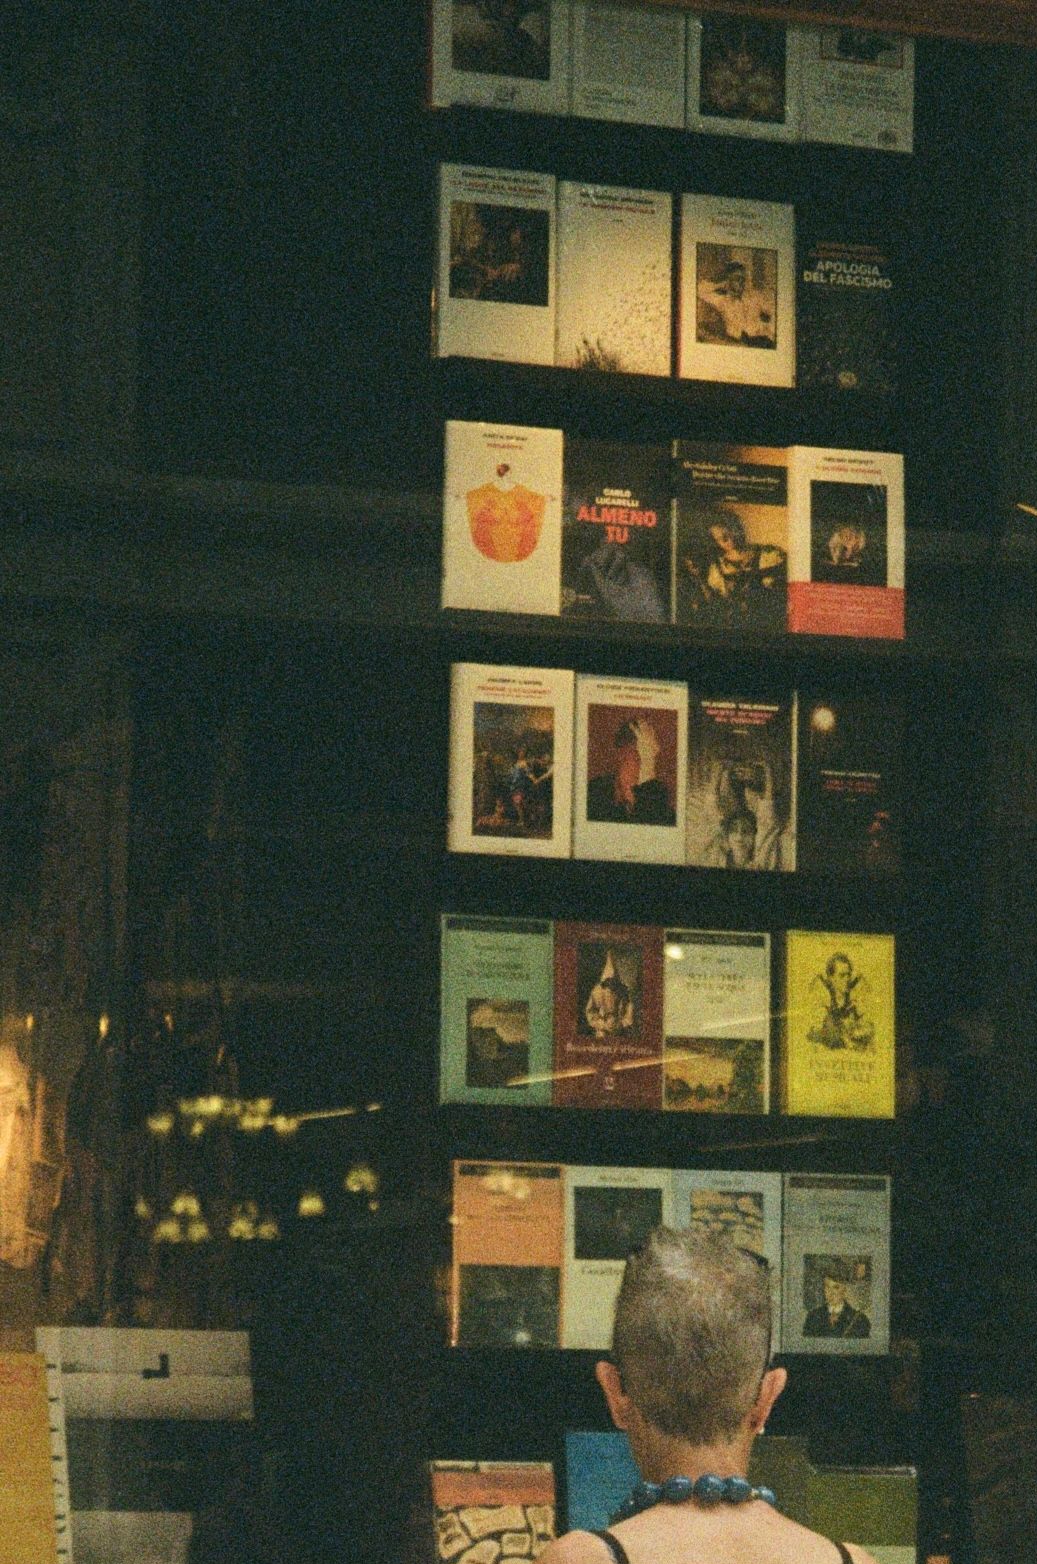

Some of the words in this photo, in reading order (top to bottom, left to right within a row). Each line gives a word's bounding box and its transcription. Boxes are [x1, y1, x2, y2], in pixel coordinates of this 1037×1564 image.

[815, 260, 881, 277] APOLOGIA
[803, 271, 827, 284] DEL
[829, 274, 893, 289] FASCISMO
[602, 487, 632, 498] CARLO
[576, 504, 657, 528] ALMENO
[605, 526, 630, 544] TU
